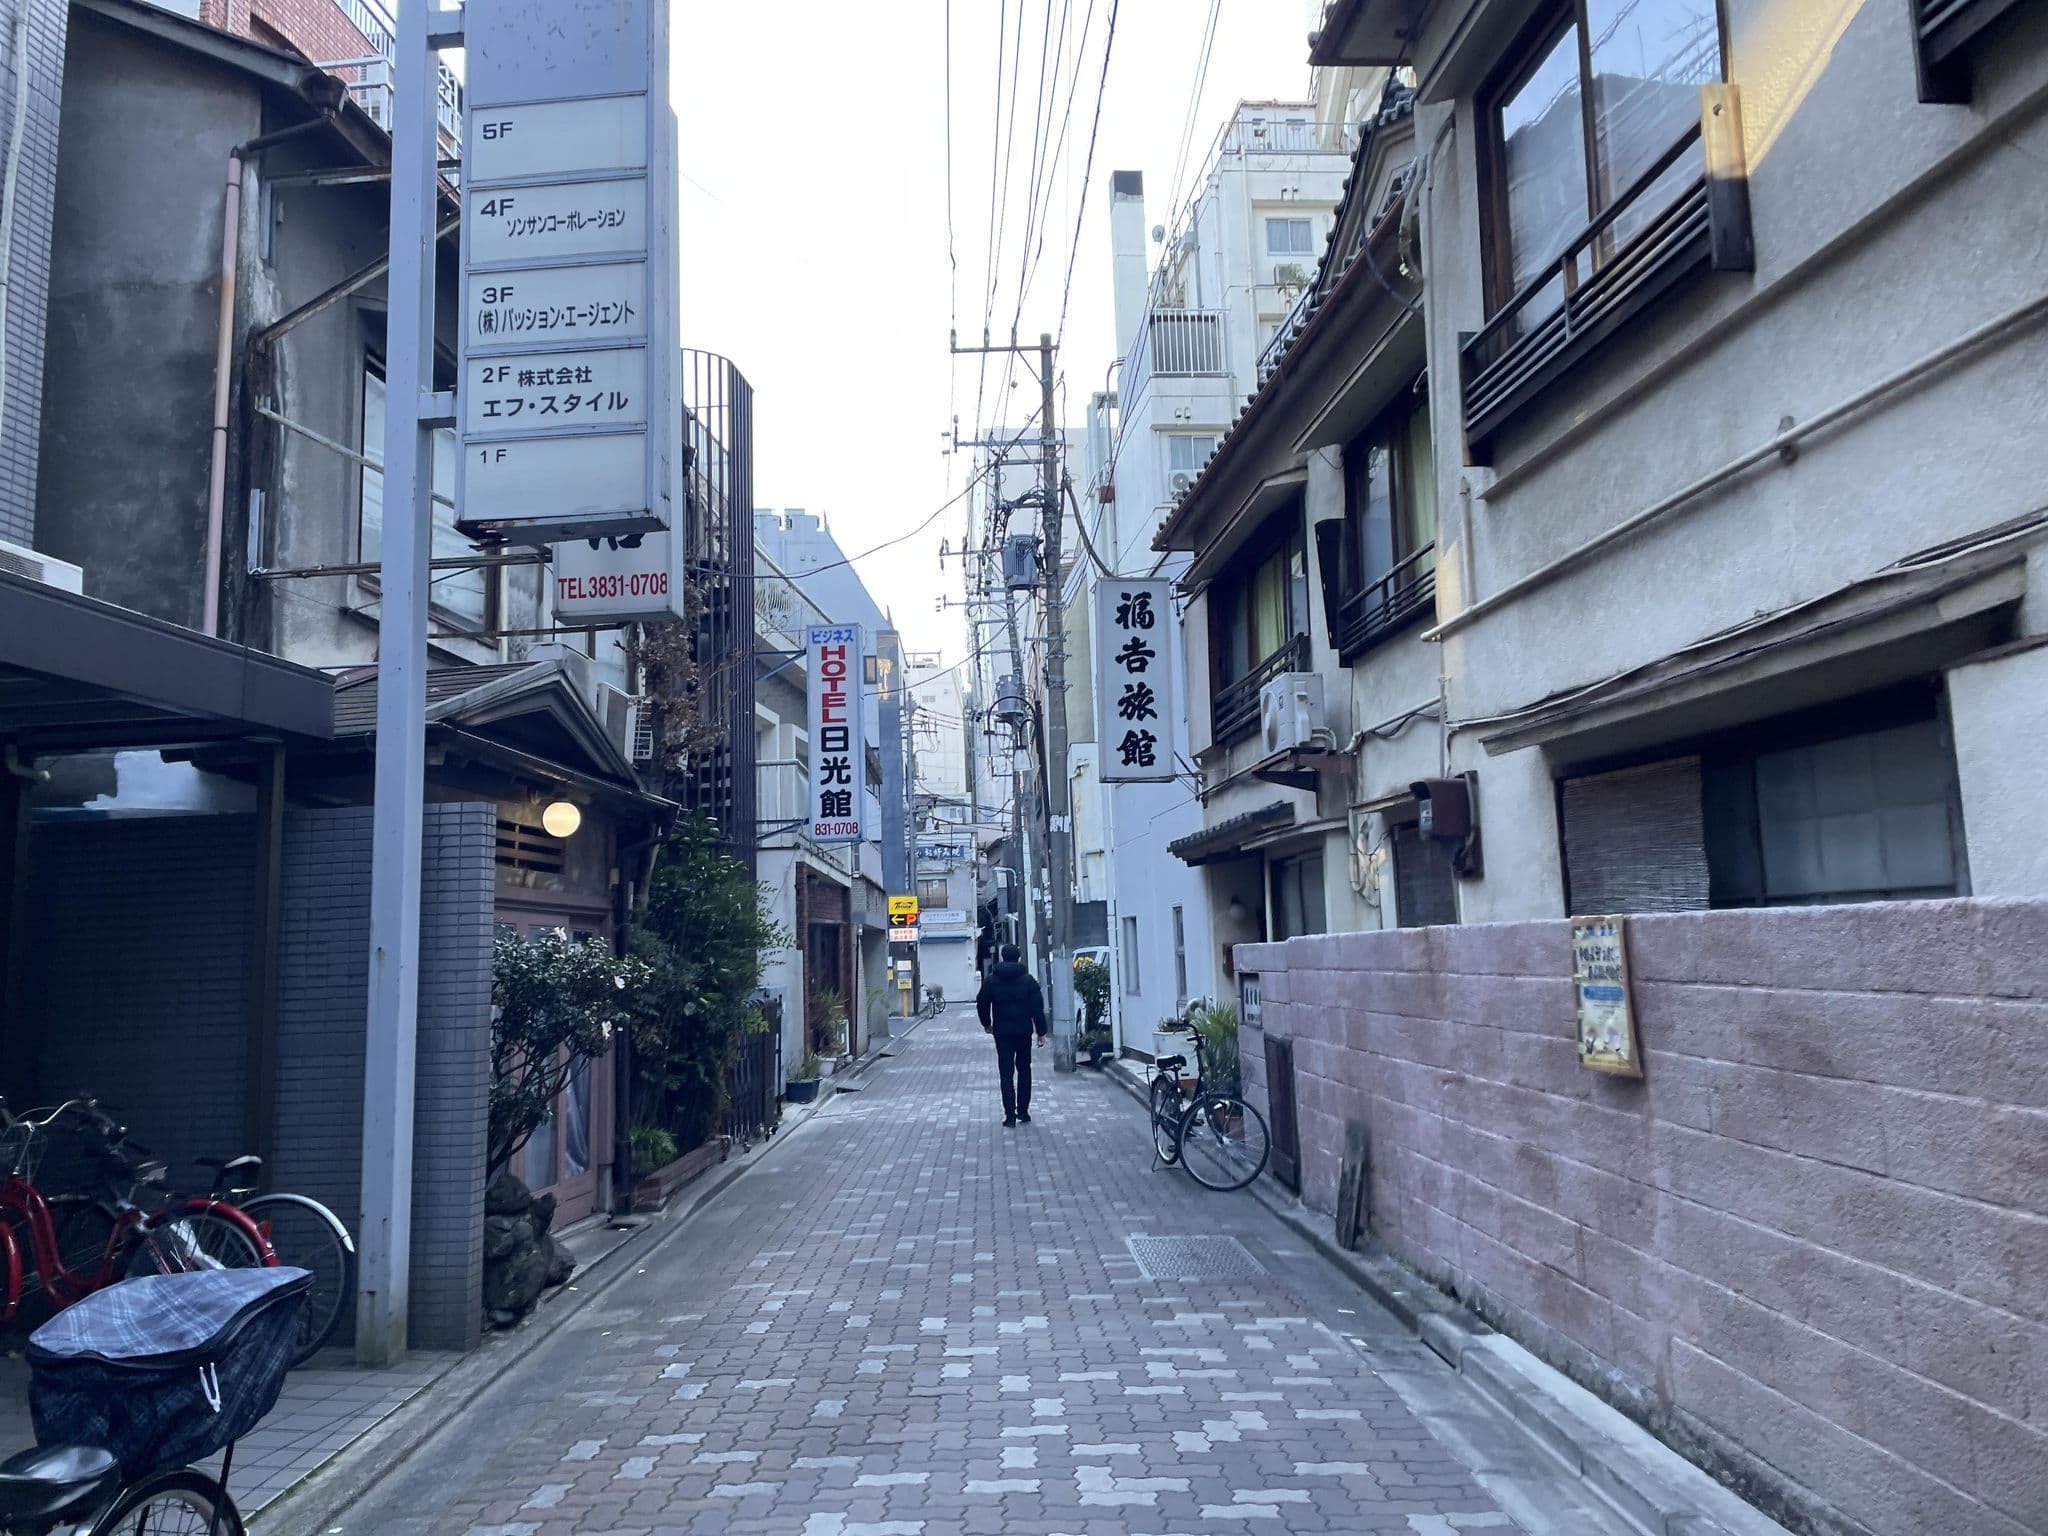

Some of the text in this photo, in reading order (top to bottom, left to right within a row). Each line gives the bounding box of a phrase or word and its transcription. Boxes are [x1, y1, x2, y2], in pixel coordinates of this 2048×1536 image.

[482, 121, 514, 140] 5F
[480, 198, 515, 218] 4F
[481, 286, 514, 304] 3F
[482, 366, 593, 388] 2F 株式会社
[482, 391, 629, 418] エフ・スタイル
[811, 628, 854, 645] ビジネス
[1114, 591, 1158, 768] 福吉旅館
[814, 821, 859, 837] 831-0708
